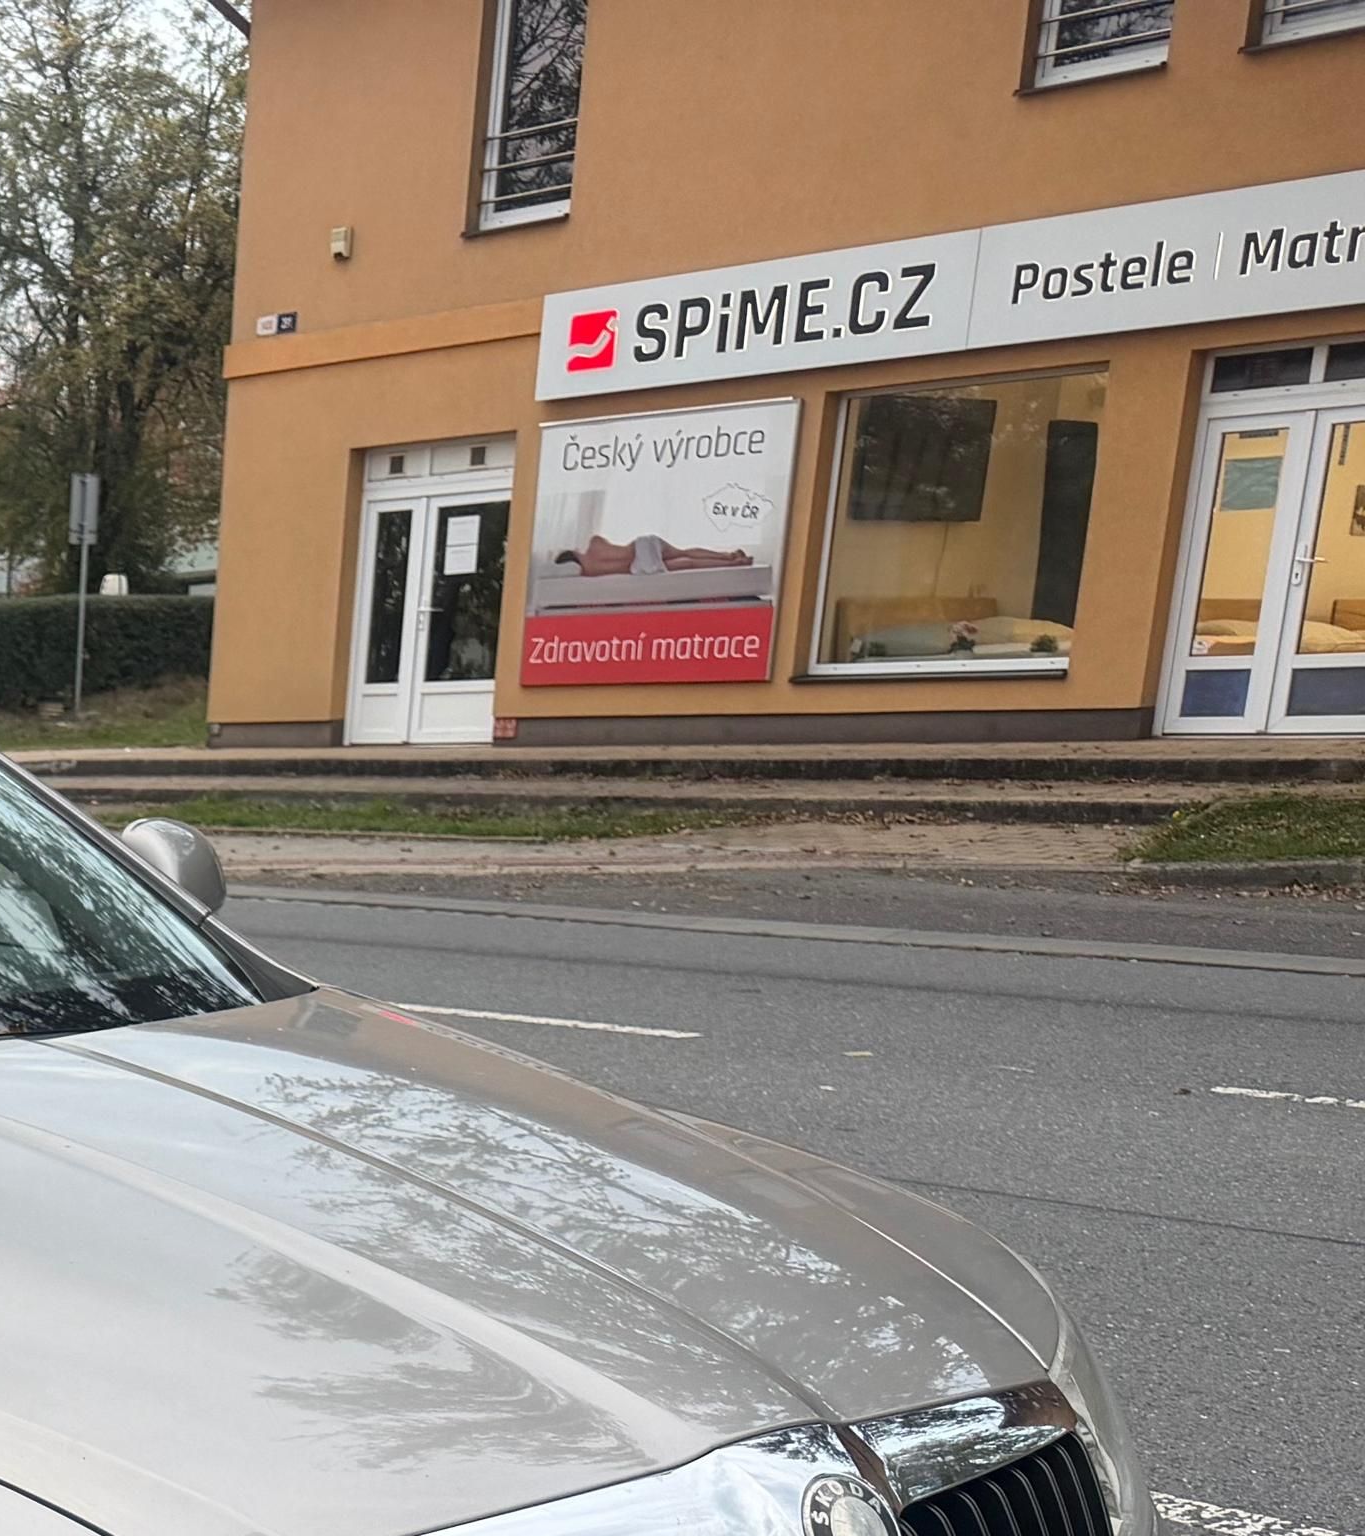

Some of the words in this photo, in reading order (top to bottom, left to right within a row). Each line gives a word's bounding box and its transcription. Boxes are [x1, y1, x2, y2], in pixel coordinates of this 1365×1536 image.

[1012, 242, 1195, 306] Postele
[634, 262, 937, 364] SPiME.CZ
[562, 433, 645, 471] Český
[653, 425, 765, 468] výrobce
[741, 501, 760, 519] ČR
[529, 632, 646, 664] Zdravotní
[652, 634, 760, 661] matrace
[810, 1479, 883, 1527] ŠKODA
